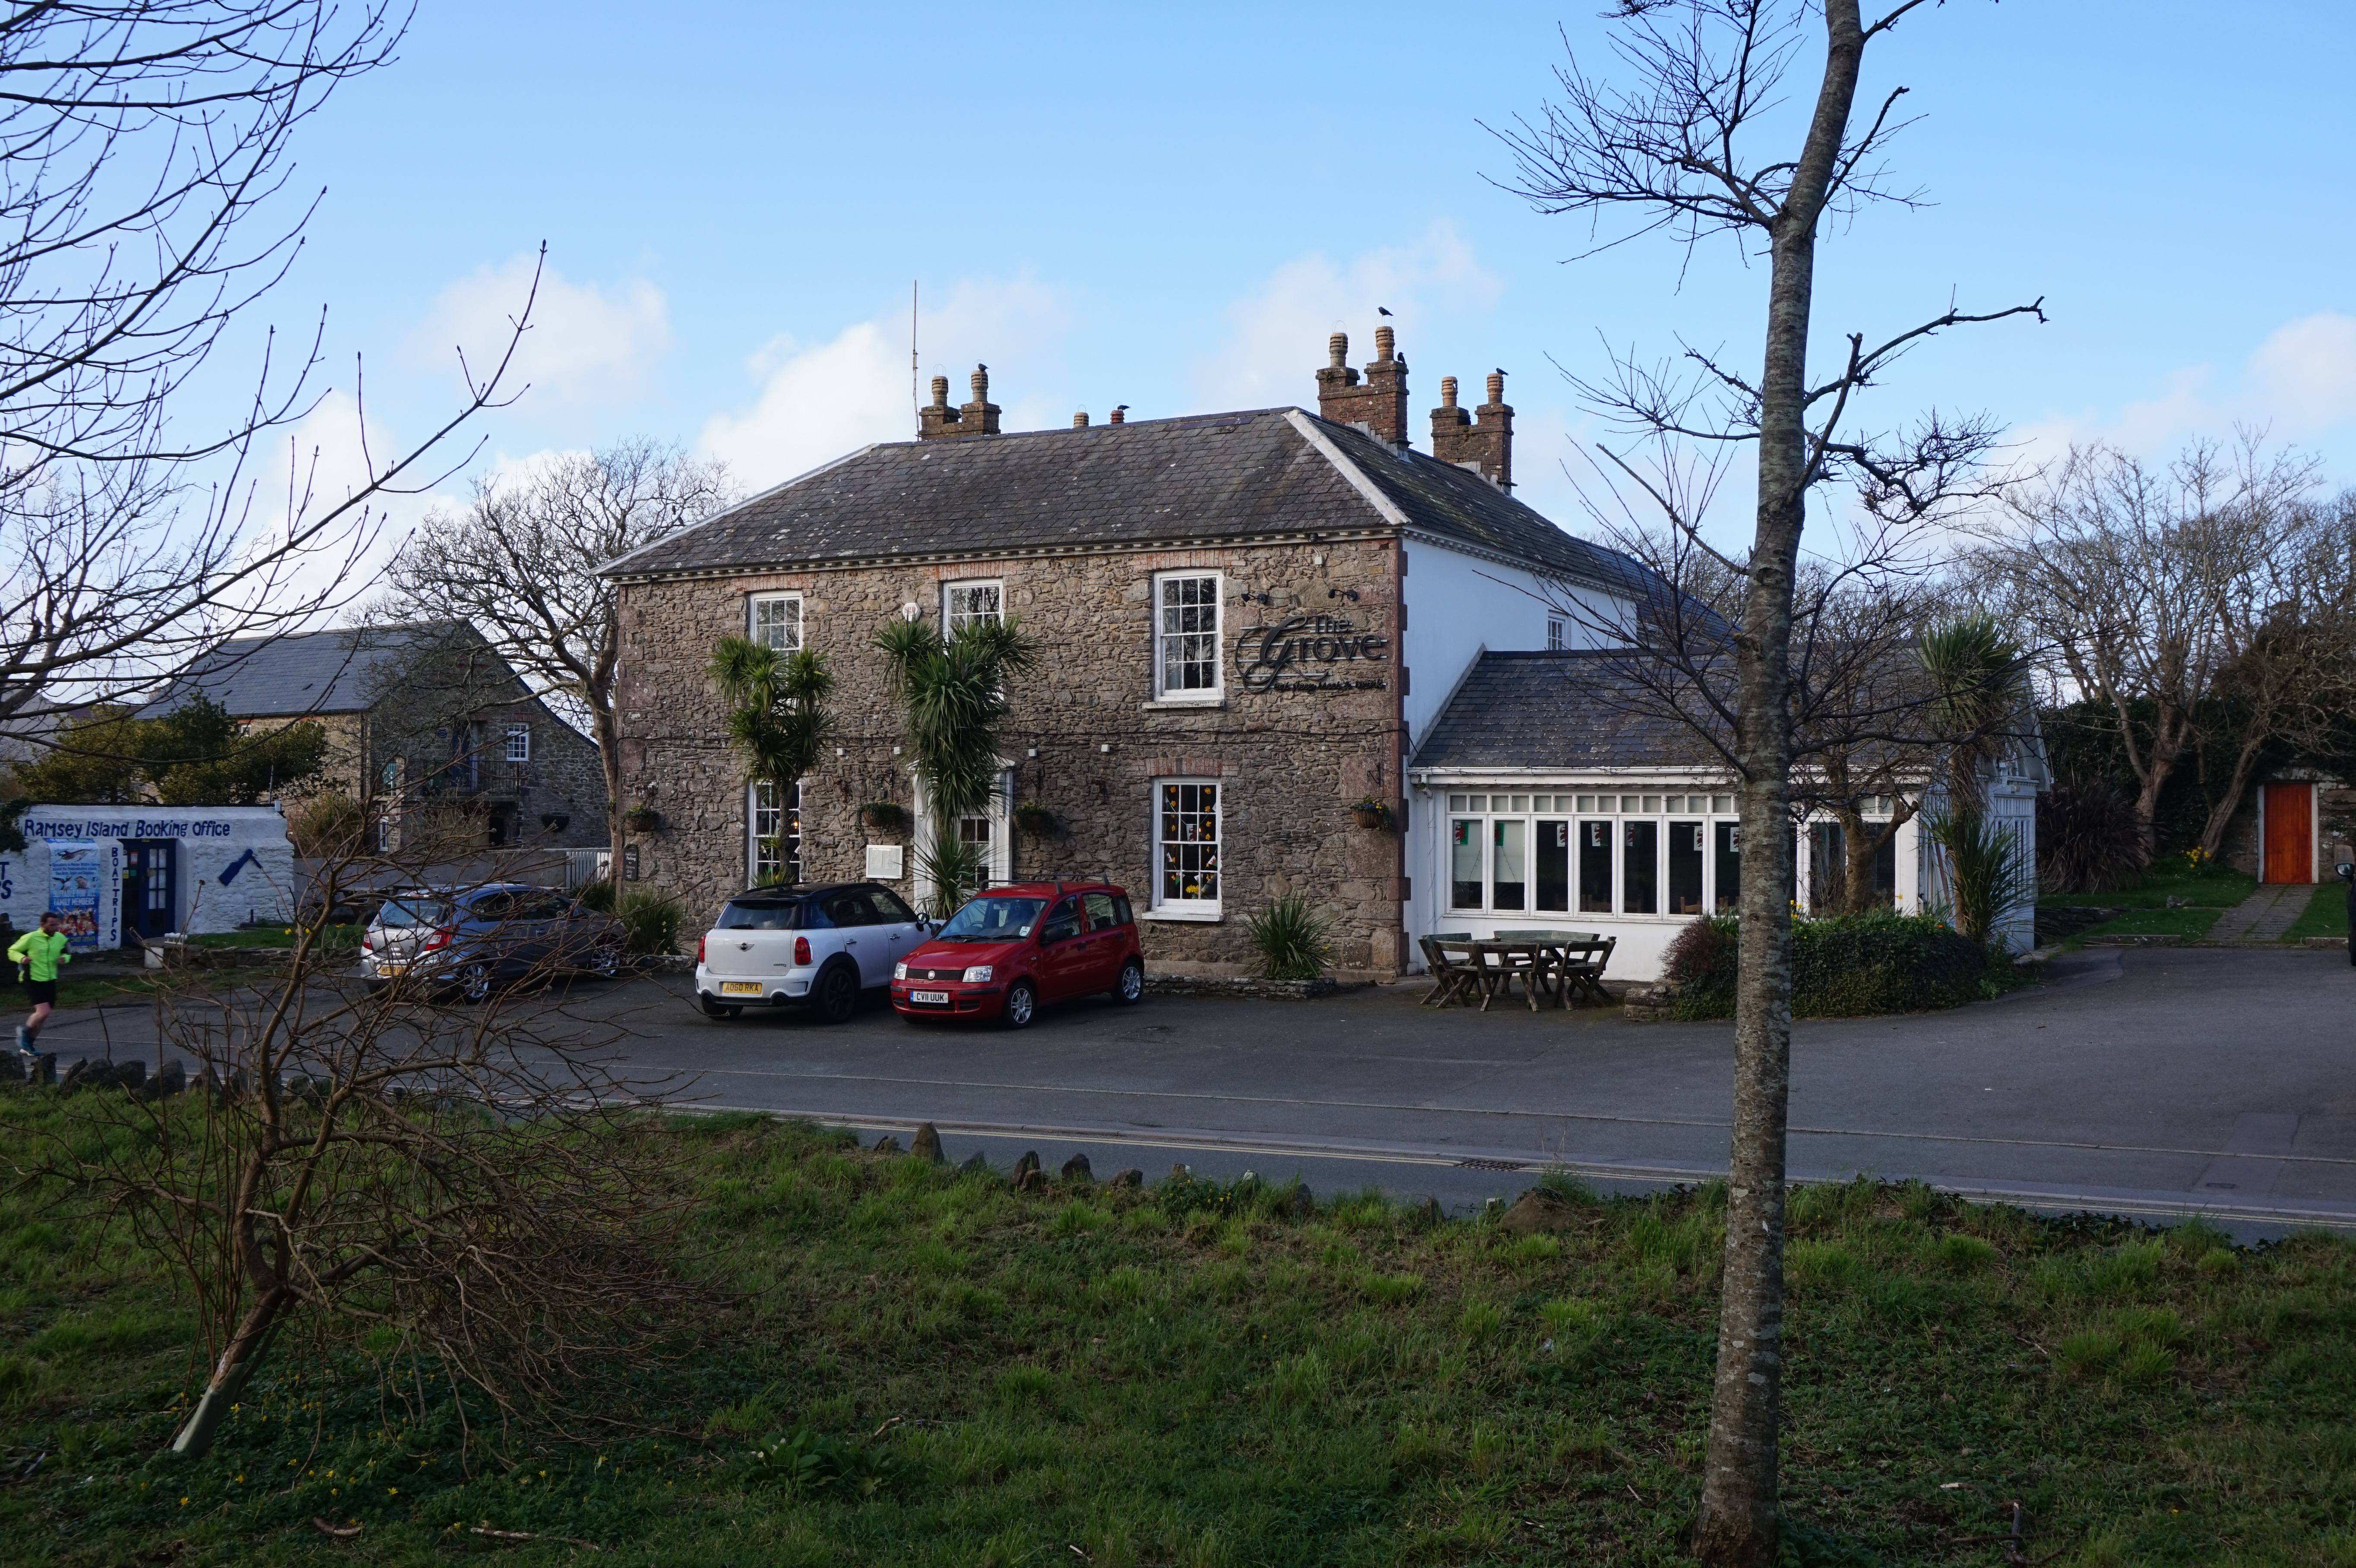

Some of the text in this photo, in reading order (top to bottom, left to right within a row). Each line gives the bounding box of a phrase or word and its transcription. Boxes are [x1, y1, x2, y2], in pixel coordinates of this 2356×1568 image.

[1311, 614, 1351, 633] The
[1235, 615, 1381, 693] Grove
[1274, 681, 1289, 690] Eat
[1318, 680, 1340, 689] Meet
[1355, 678, 1383, 689] Drink
[24, 819, 231, 838] Ramsey Island Booking Office
[72, 897, 95, 905] MEMBERS
[110, 889, 120, 942] TRIPS
[725, 983, 758, 992] AO60 RKA
[917, 993, 944, 1002] CV11 UUK
